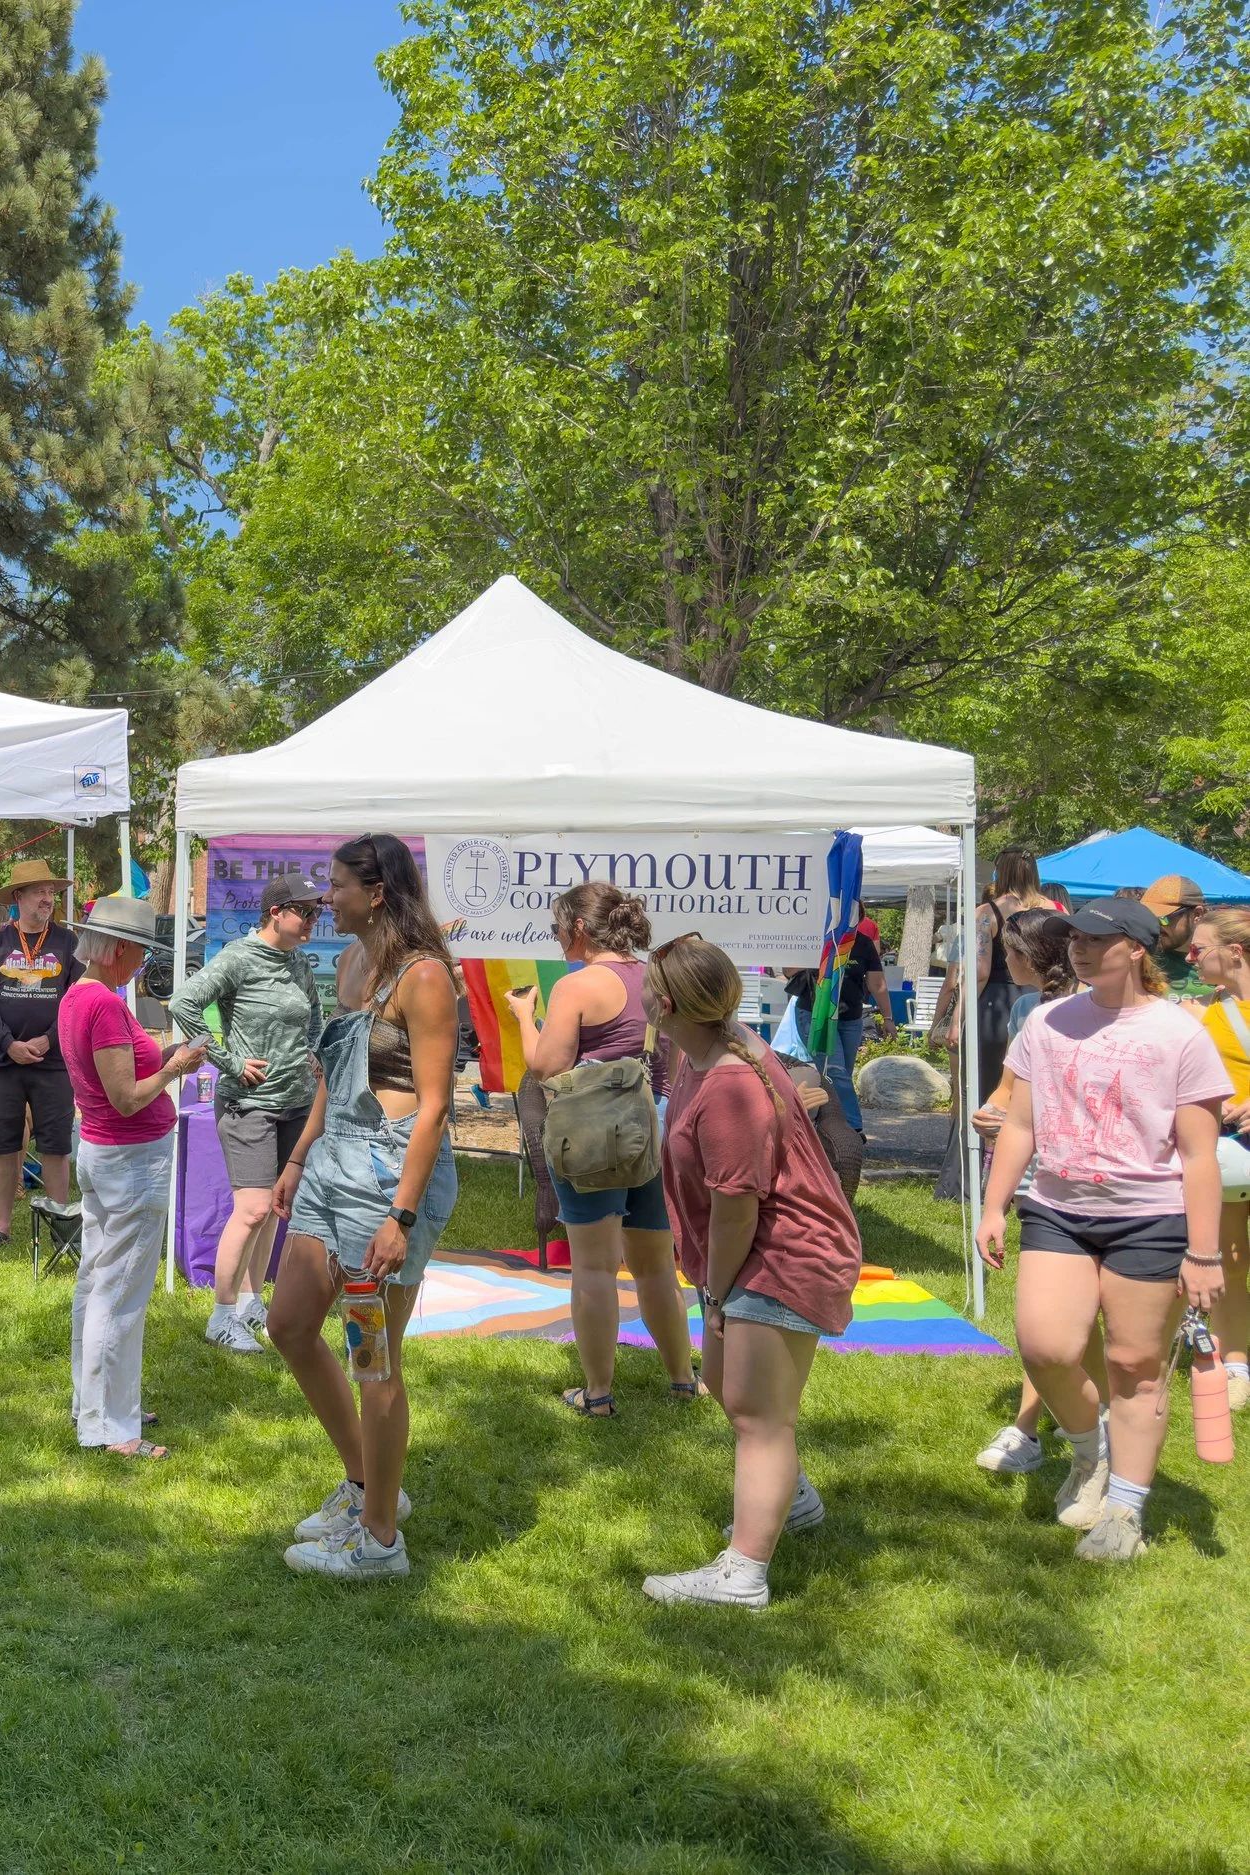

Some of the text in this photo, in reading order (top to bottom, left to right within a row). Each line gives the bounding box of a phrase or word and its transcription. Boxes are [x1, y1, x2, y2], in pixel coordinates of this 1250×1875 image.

[214, 860, 243, 879] BE
[252, 860, 301, 880] THE
[445, 840, 509, 883] UNITED CHURCH OF CHRIST
[223, 890, 261, 909] Prote
[448, 890, 457, 905] THAT
[456, 903, 468, 914] THEY
[756, 895, 807, 915] UCC
[471, 930, 496, 942] are
[501, 921, 559, 944] welcom
